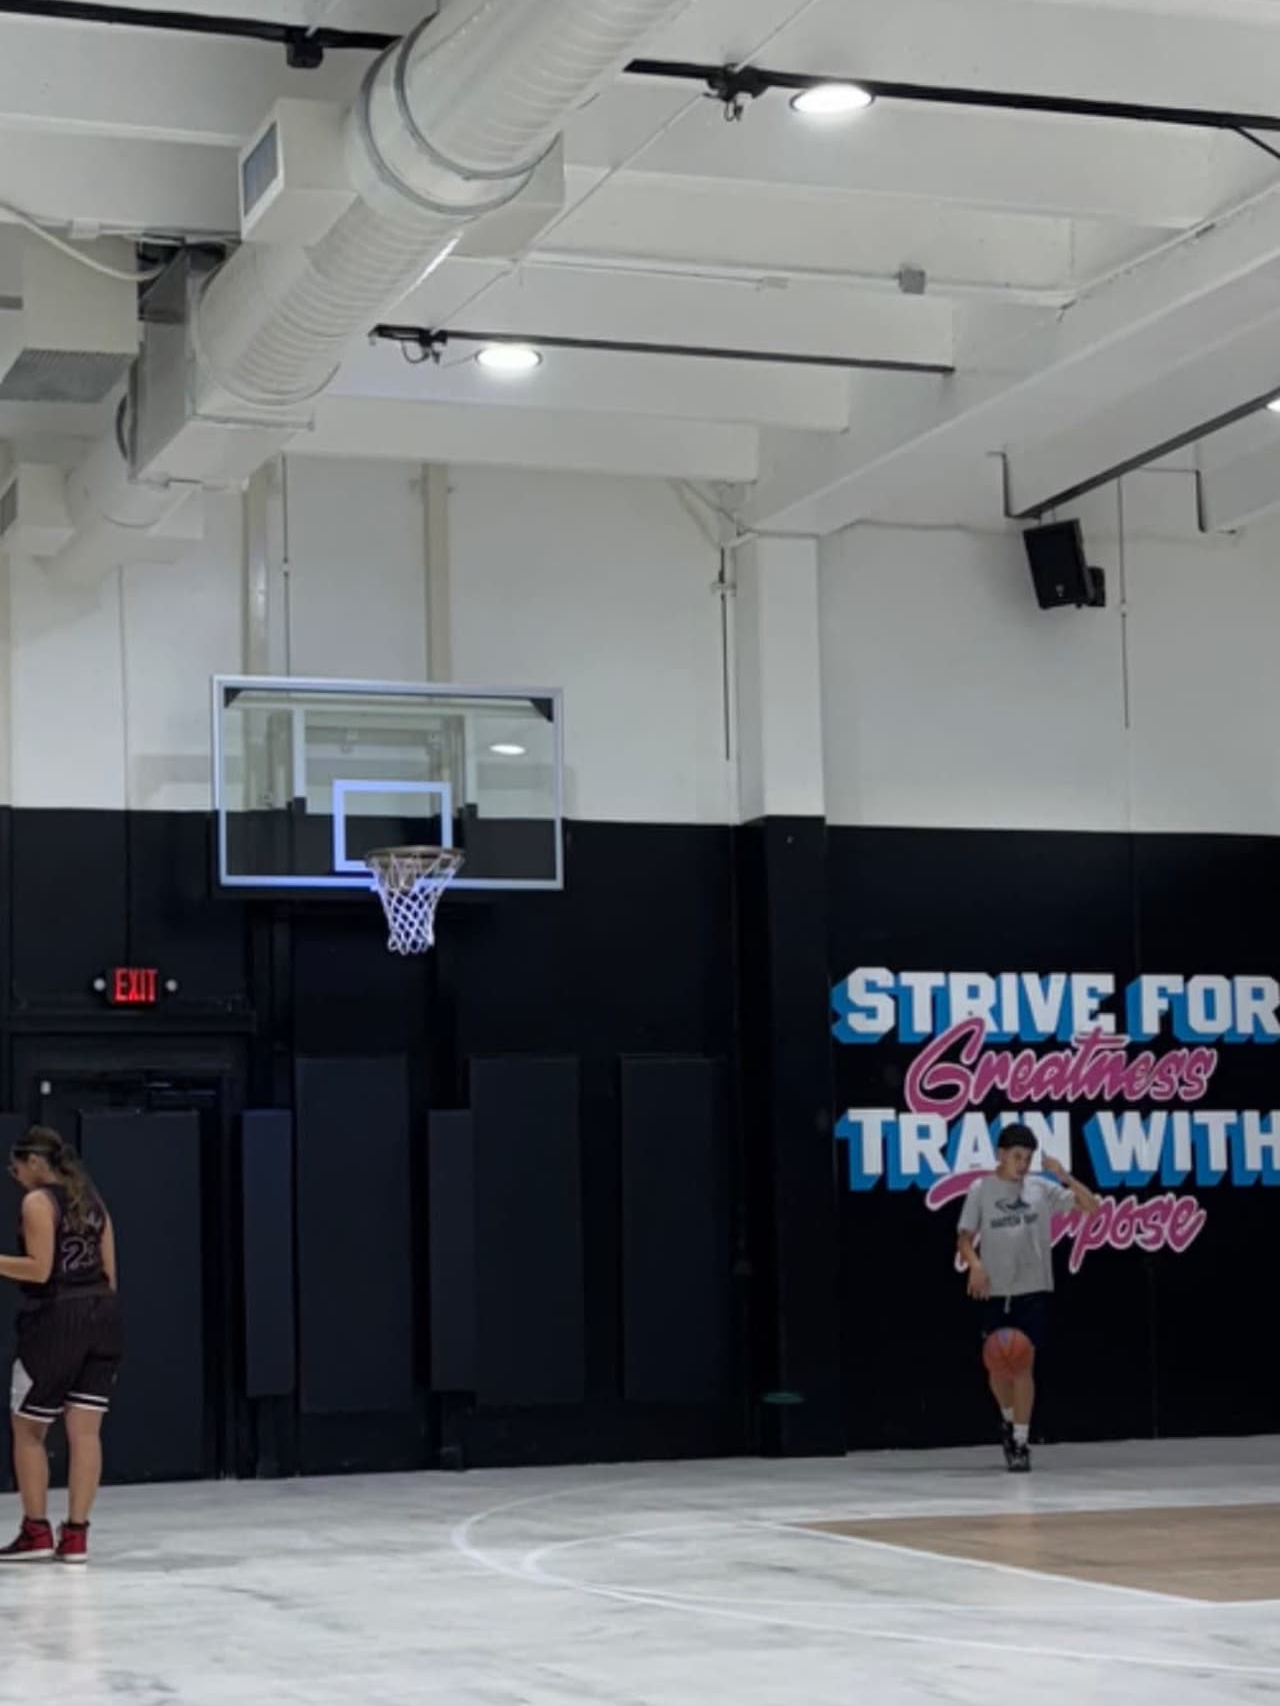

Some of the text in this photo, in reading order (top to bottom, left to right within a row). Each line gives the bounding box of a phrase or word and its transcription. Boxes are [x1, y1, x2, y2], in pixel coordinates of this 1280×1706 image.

[114, 966, 159, 1002] EXIT
[831, 967, 1115, 1043] STRIVE
[904, 1016, 1218, 1121] Greatness
[835, 1109, 1072, 1191] TRAN
[925, 1168, 1206, 1273] rpose
